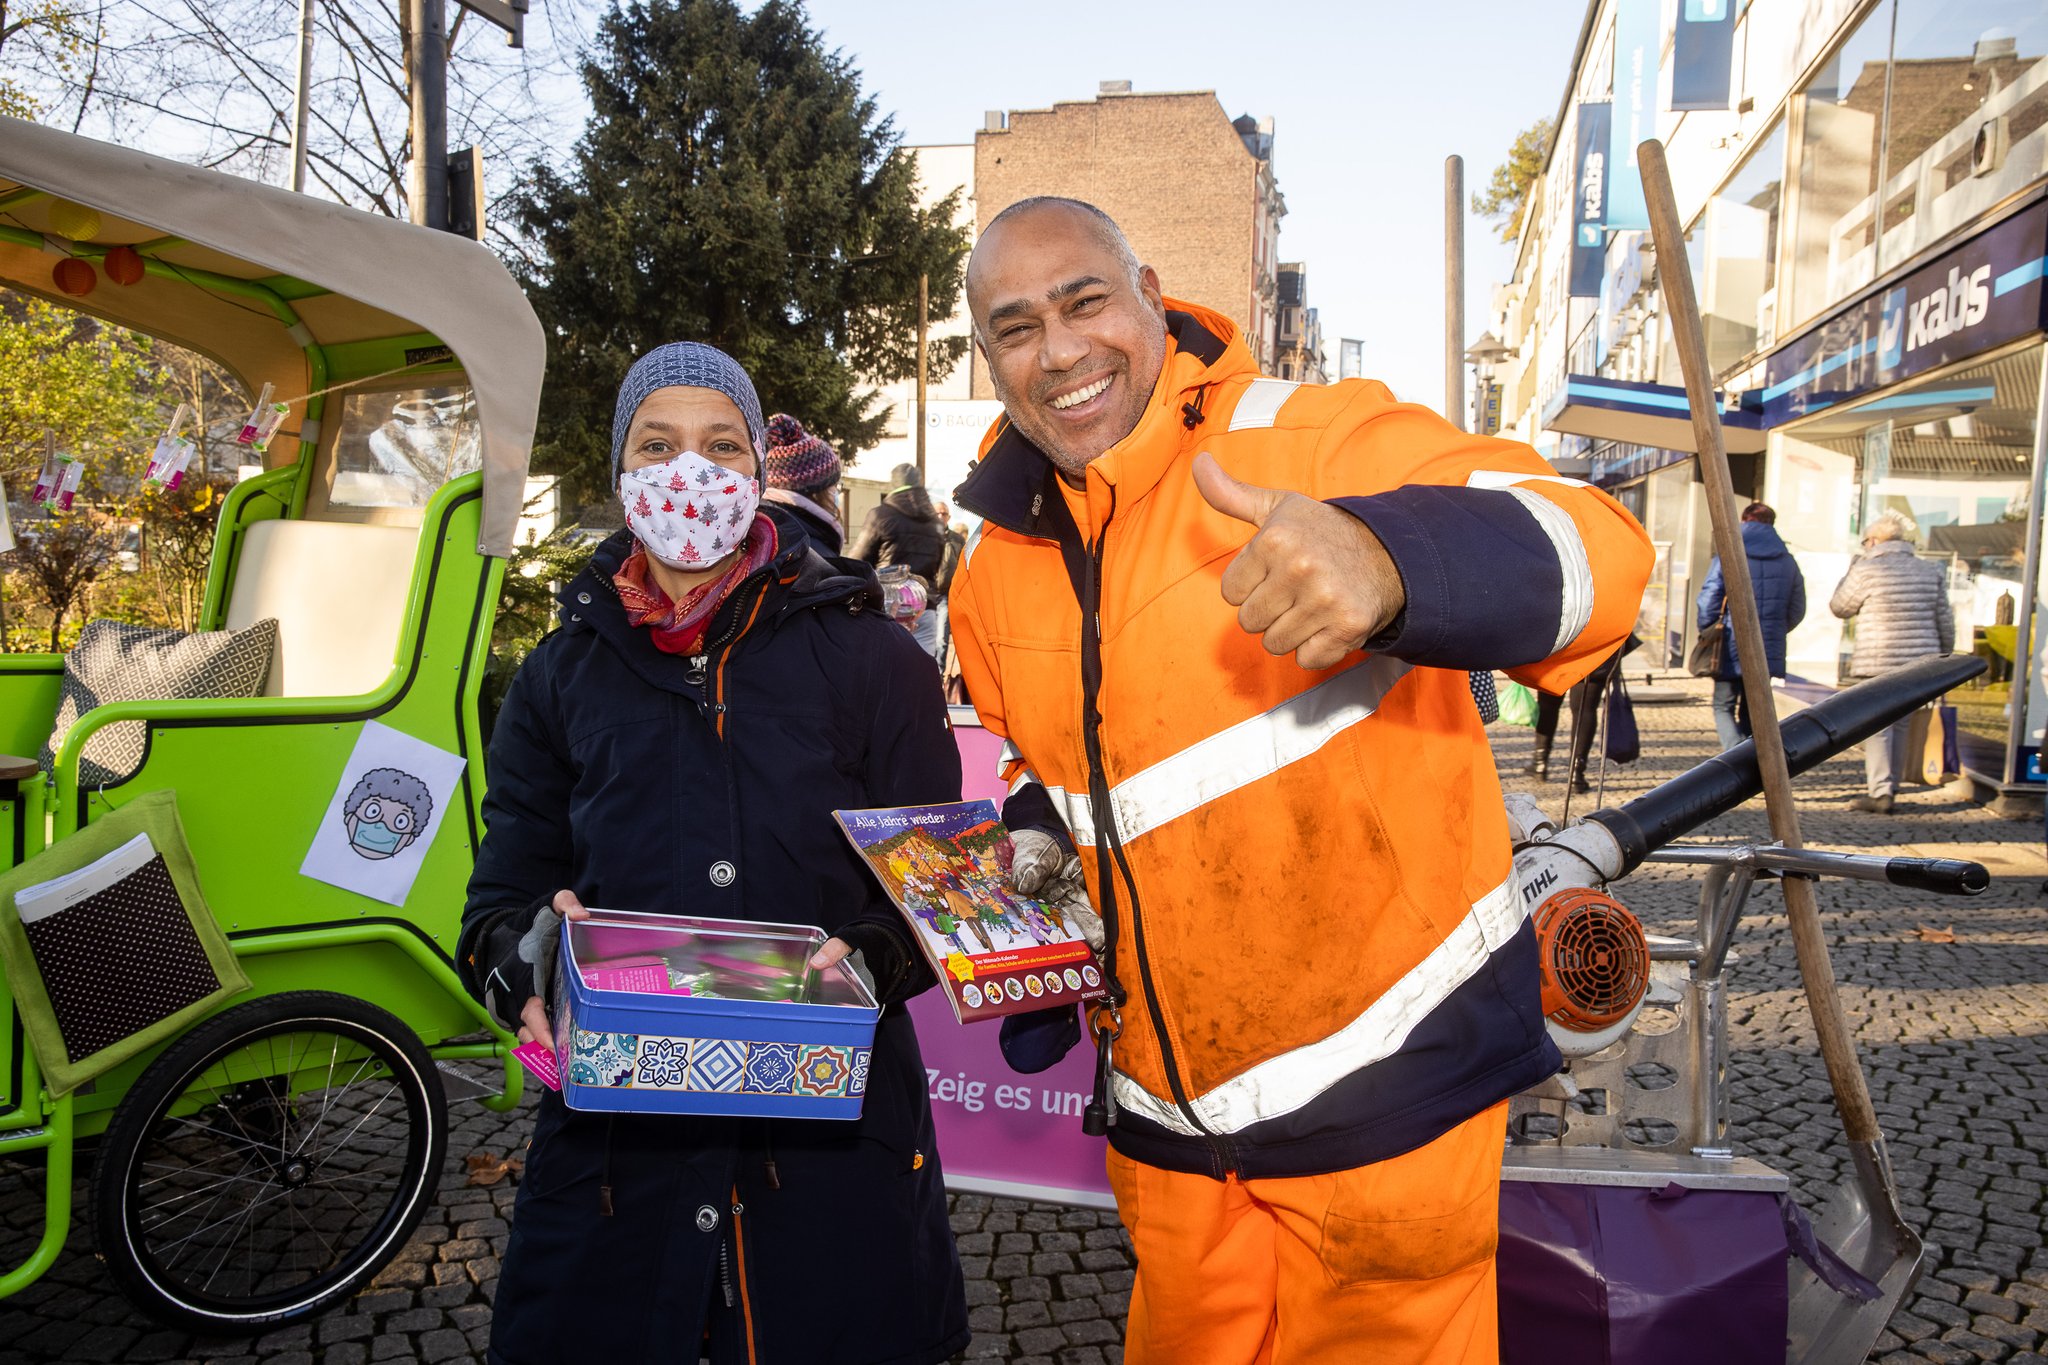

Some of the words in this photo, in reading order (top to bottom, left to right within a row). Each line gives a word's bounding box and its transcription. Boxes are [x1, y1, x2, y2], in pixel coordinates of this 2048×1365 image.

[855, 816, 877, 828] Alle
[877, 815, 909, 828] Jahre
[910, 813, 945, 825] wieder
[1522, 869, 1559, 904] TIHL
[925, 1068, 987, 1112] Zeig
[994, 1083, 1031, 1111] es
